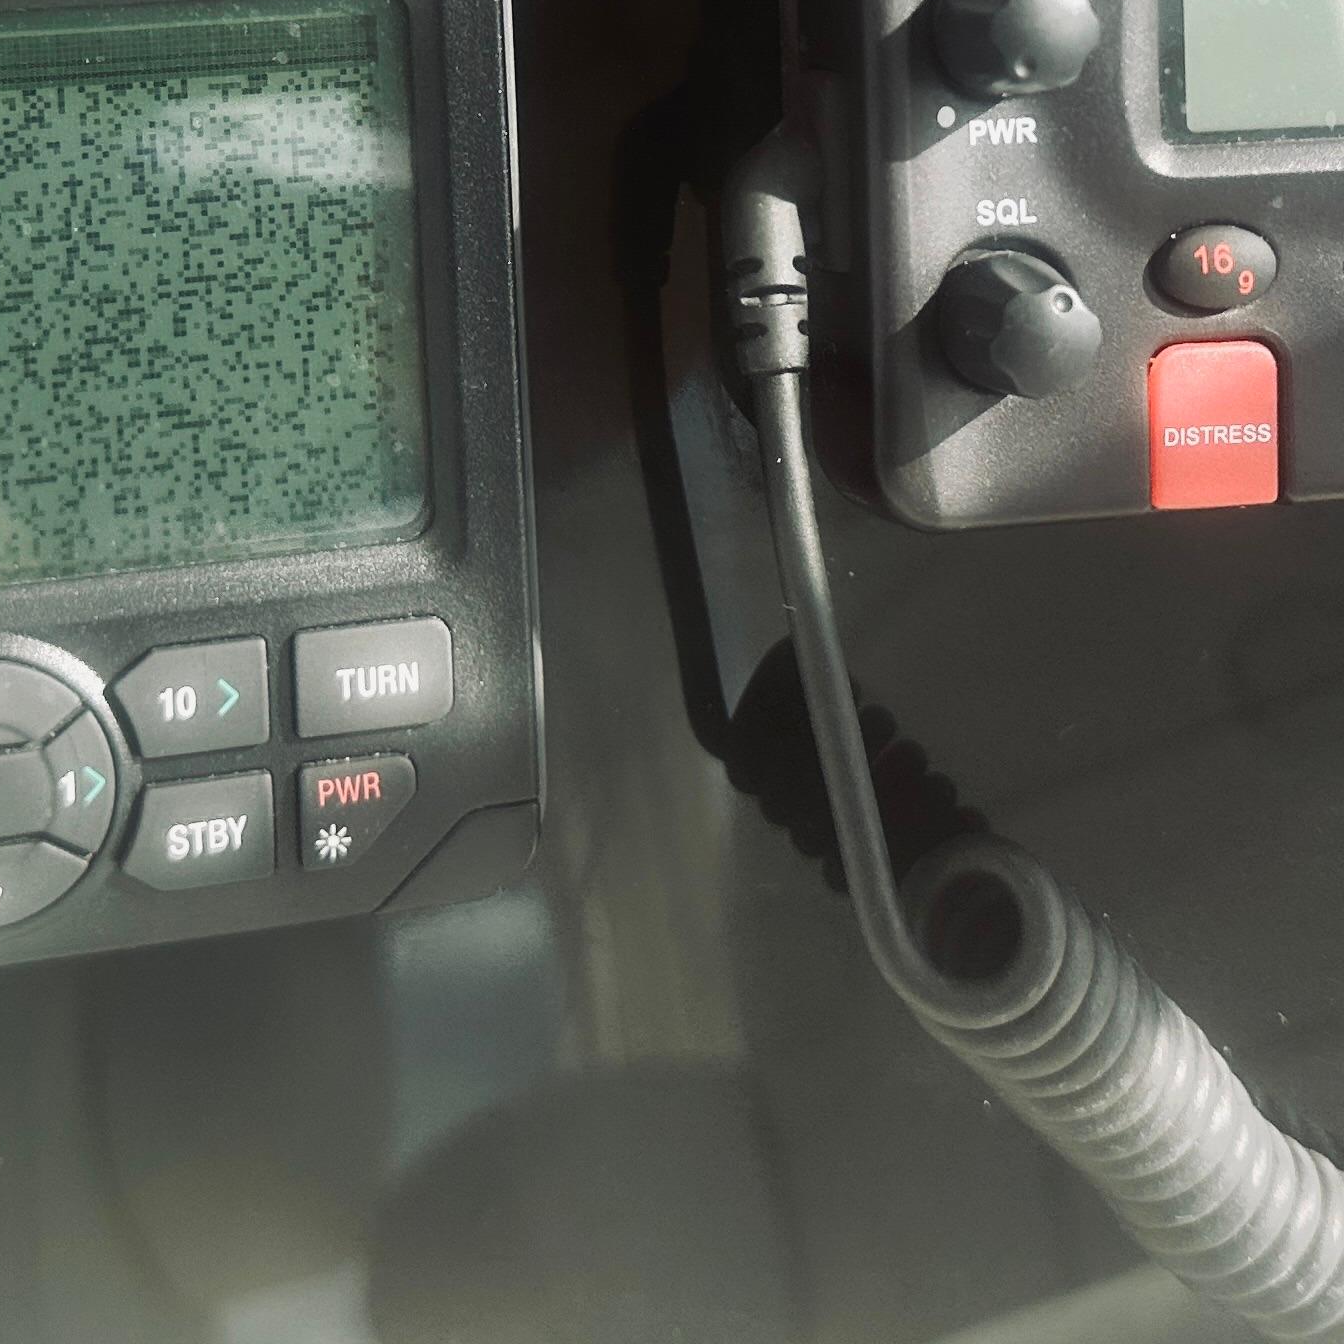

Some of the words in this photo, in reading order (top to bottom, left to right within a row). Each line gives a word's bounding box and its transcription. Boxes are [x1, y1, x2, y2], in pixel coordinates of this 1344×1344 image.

[968, 117, 1037, 146] PWR
[975, 199, 1037, 227] SQL
[1193, 244, 1234, 275] 16
[1237, 269, 1254, 296] 9
[1163, 423, 1271, 447] DISTRESS
[336, 662, 421, 702] TURN
[159, 686, 196, 721] 10
[317, 770, 382, 808] PWR
[167, 815, 248, 860] STBY
